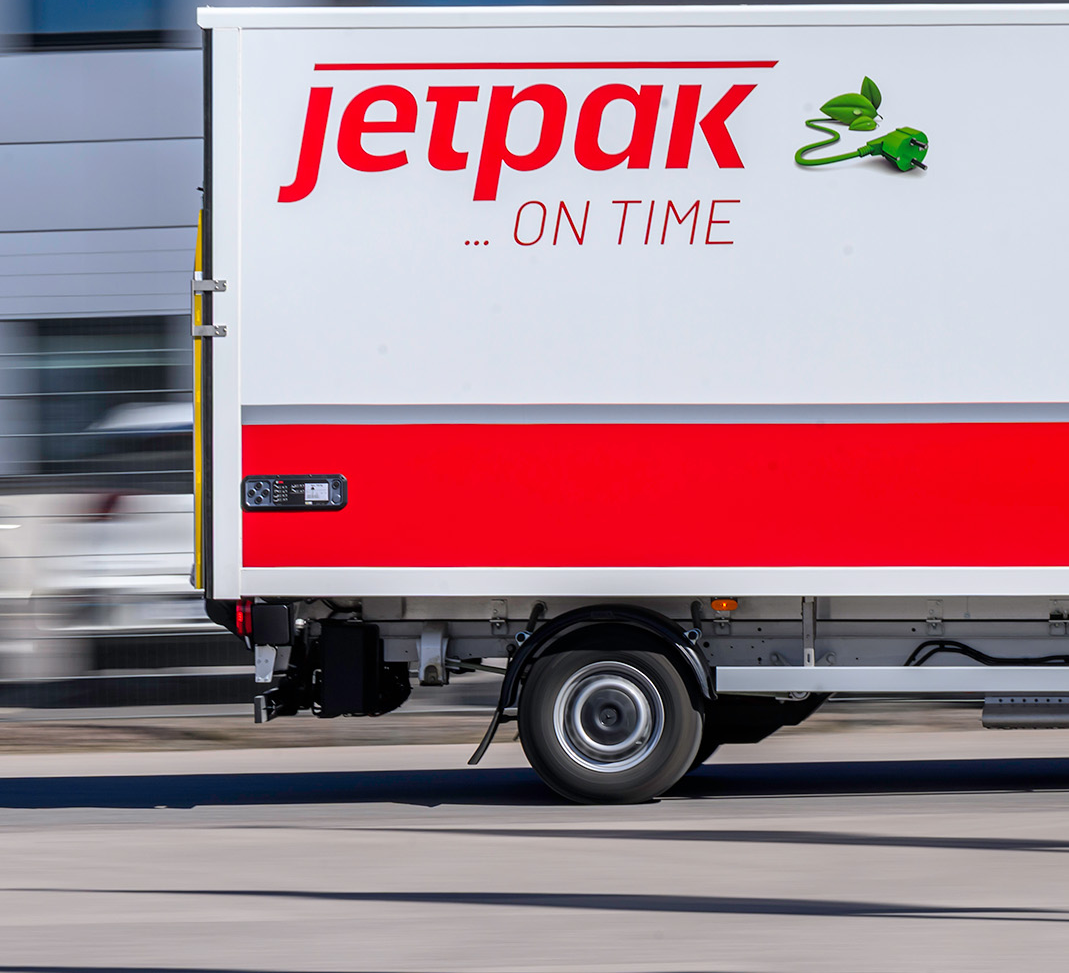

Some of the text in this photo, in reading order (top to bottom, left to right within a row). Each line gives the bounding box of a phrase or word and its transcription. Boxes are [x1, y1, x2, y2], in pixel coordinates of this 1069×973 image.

[278, 84, 757, 203] jetpak
[514, 200, 590, 246] ON
[612, 199, 740, 246] TIME
